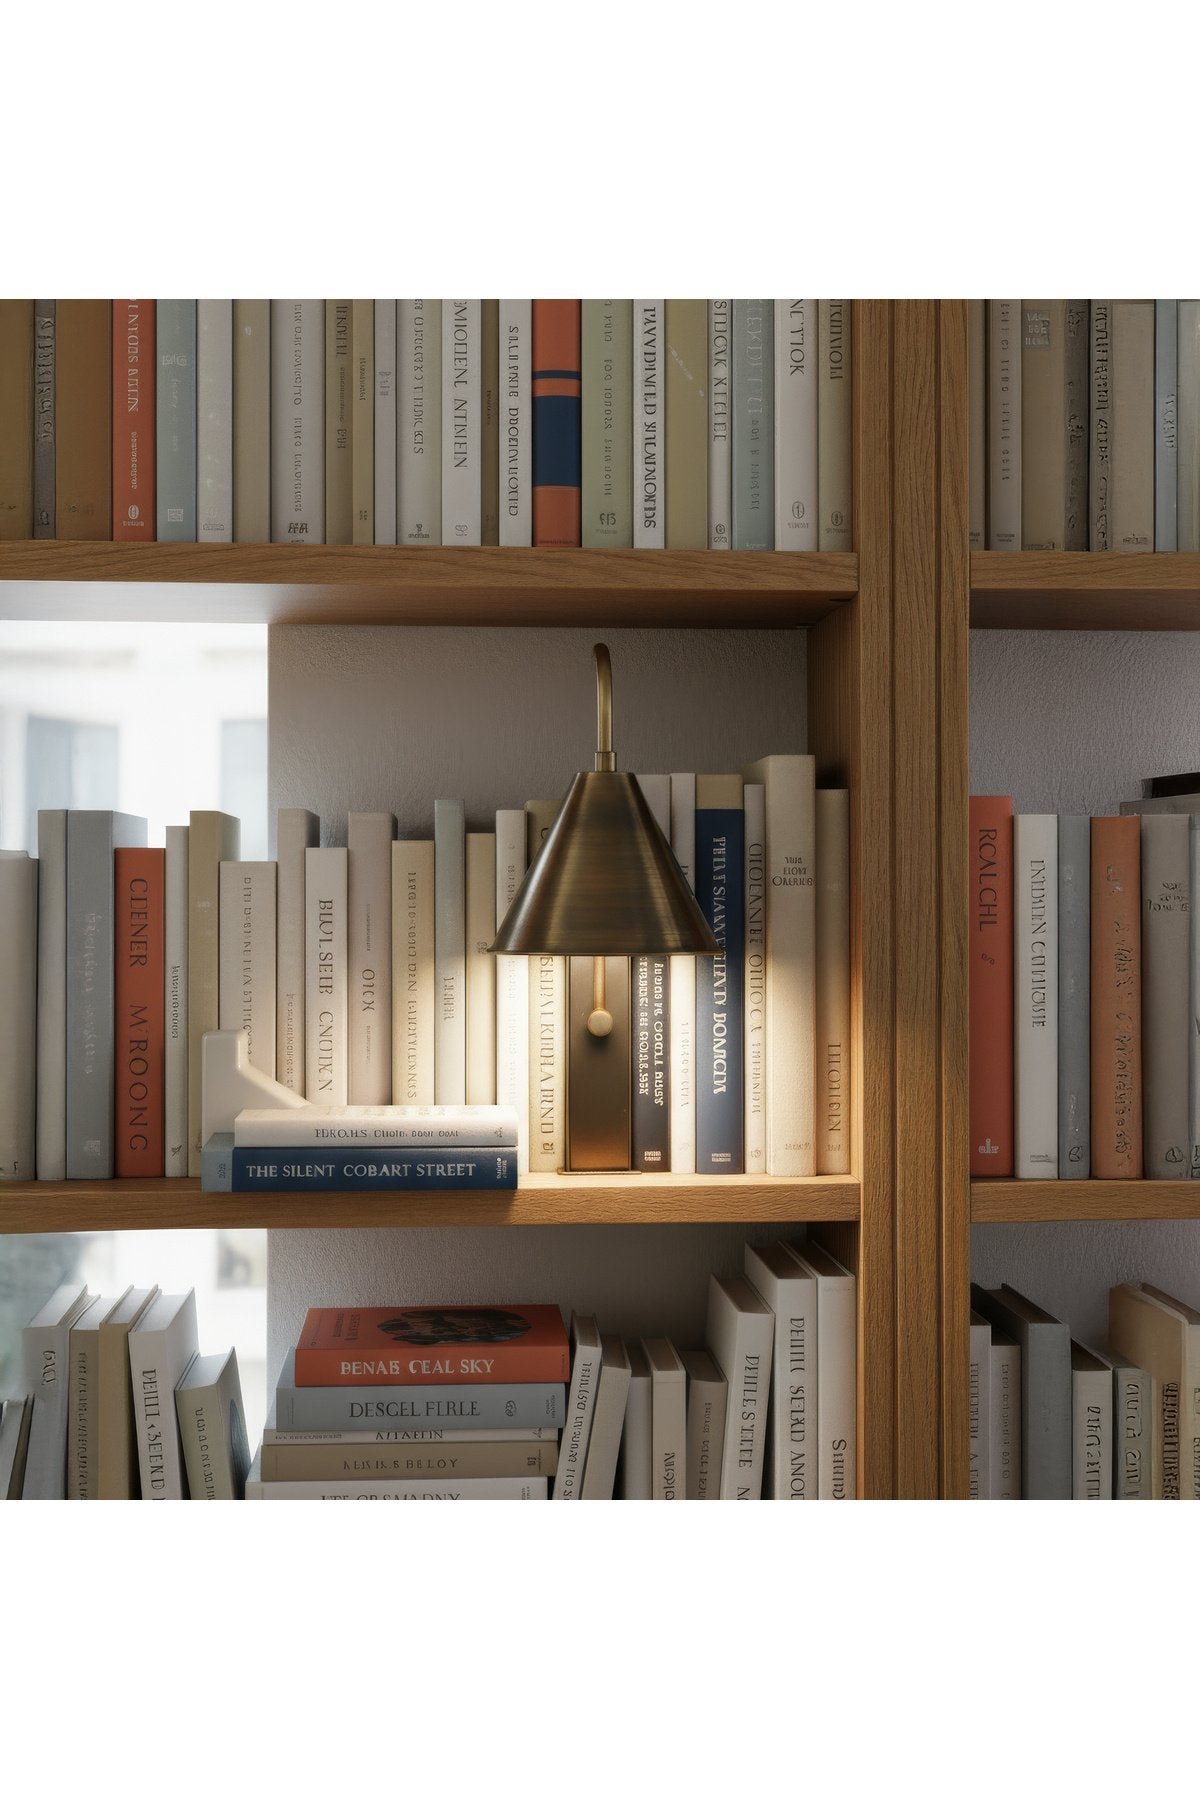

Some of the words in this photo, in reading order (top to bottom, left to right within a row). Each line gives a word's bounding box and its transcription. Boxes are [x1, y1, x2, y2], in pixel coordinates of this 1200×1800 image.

[246, 1165, 278, 1178] THE
[282, 1165, 335, 1178] SILENT
[343, 1164, 411, 1178] COBART
[415, 1163, 477, 1177] STREET
[460, 1358, 495, 1374] SKY
